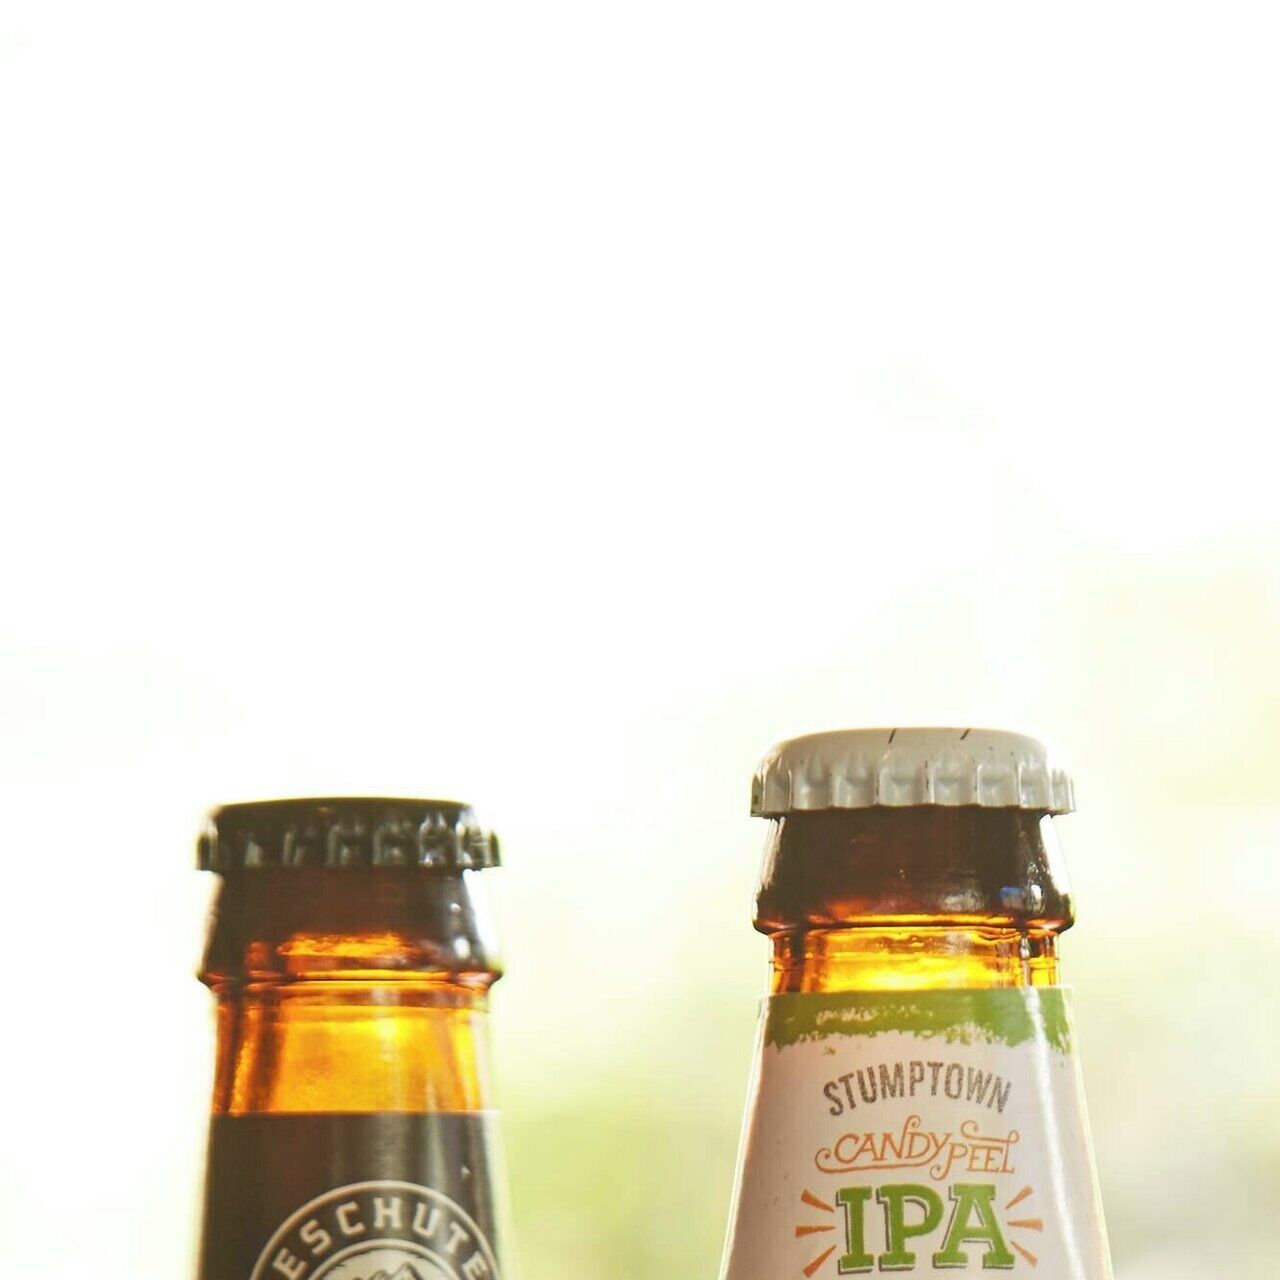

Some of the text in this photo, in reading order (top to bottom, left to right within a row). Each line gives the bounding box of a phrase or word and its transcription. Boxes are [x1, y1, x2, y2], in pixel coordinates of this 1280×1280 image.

[823, 1060, 1013, 1117] STUMPTOWN
[814, 1113, 1020, 1181] CANDY PEEL
[834, 1182, 1017, 1276] IPA
